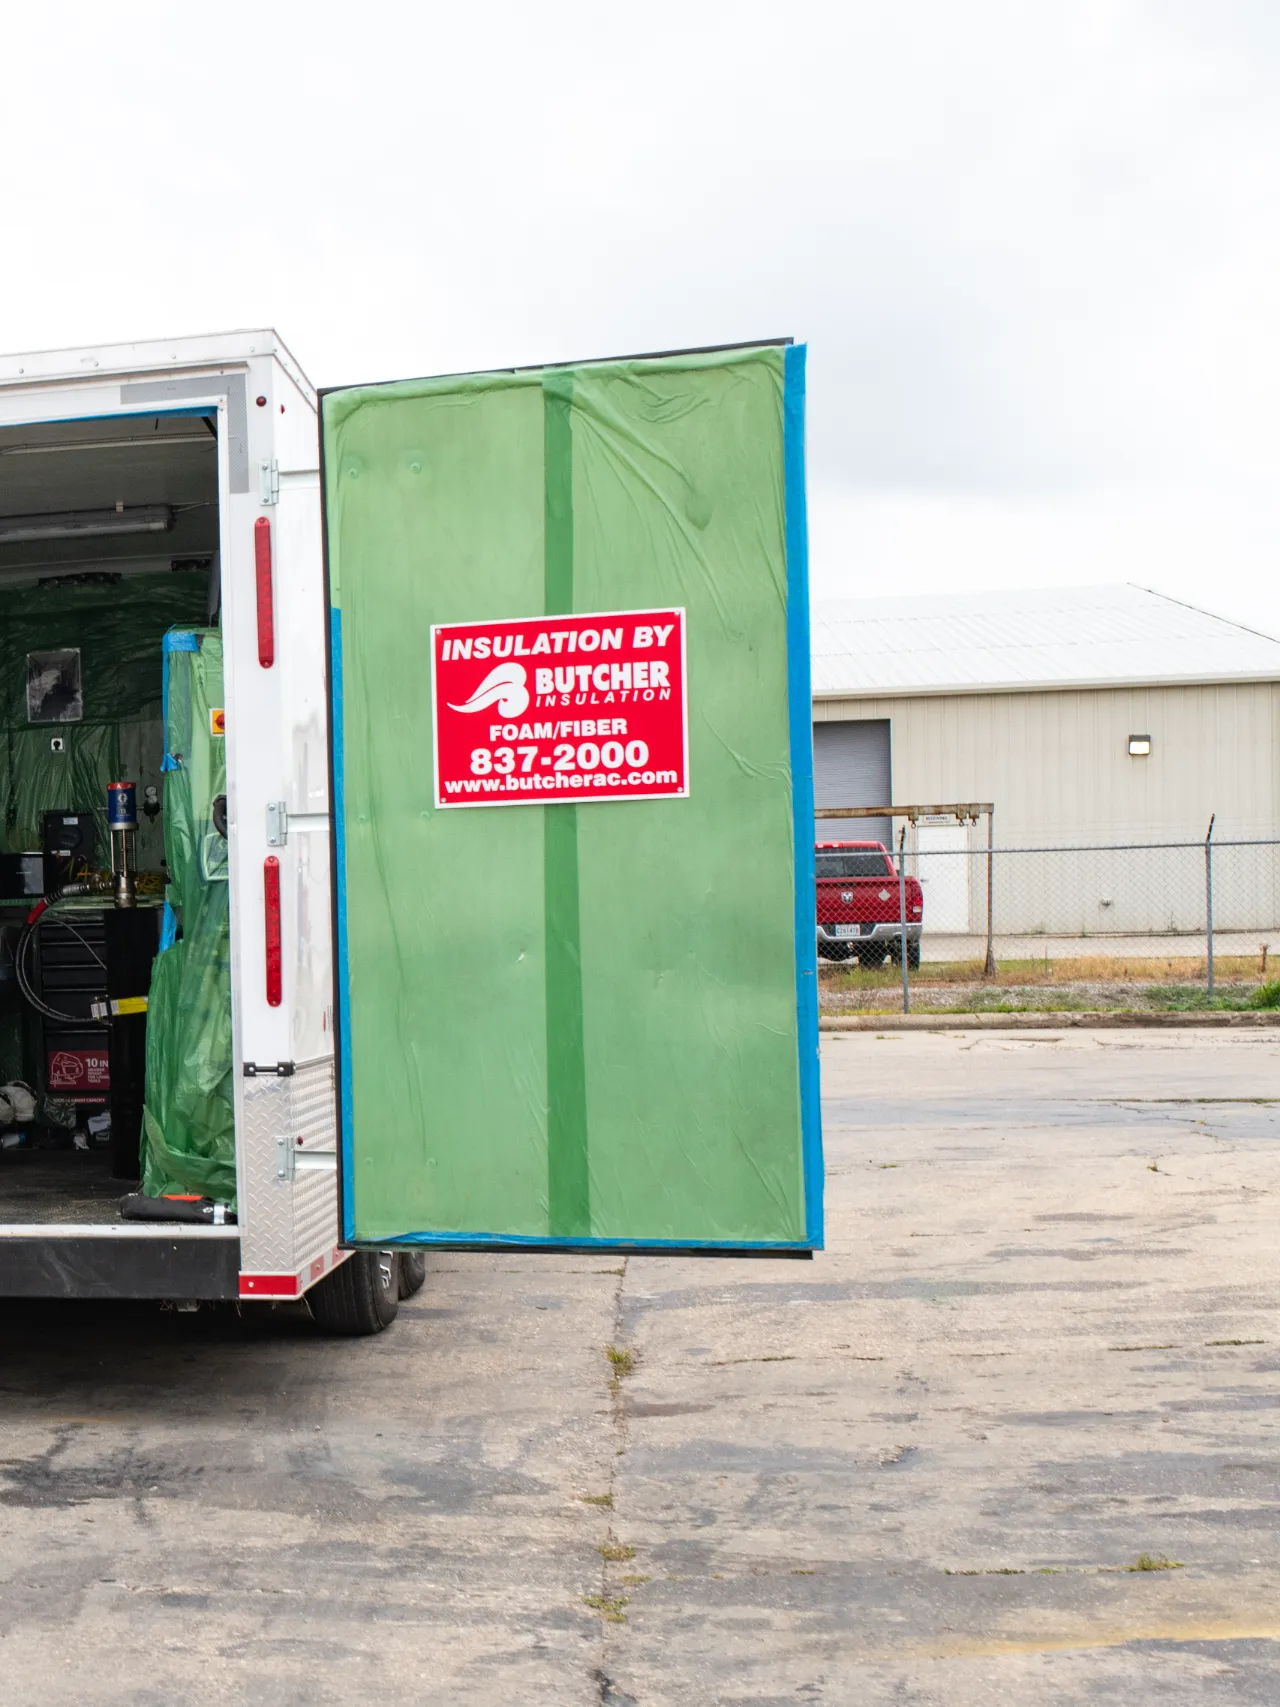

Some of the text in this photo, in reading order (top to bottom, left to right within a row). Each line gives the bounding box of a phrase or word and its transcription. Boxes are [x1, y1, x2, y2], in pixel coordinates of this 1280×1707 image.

[441, 624, 675, 661] INSULATION BY
[535, 660, 670, 695] BUTCHER
[535, 687, 672, 708] INSULATION
[489, 717, 628, 742] FOAM/FIBER
[470, 740, 649, 775] 837-2000
[444, 769, 678, 794] www.butcherac.com
[85, 1058, 98, 1068] 10
